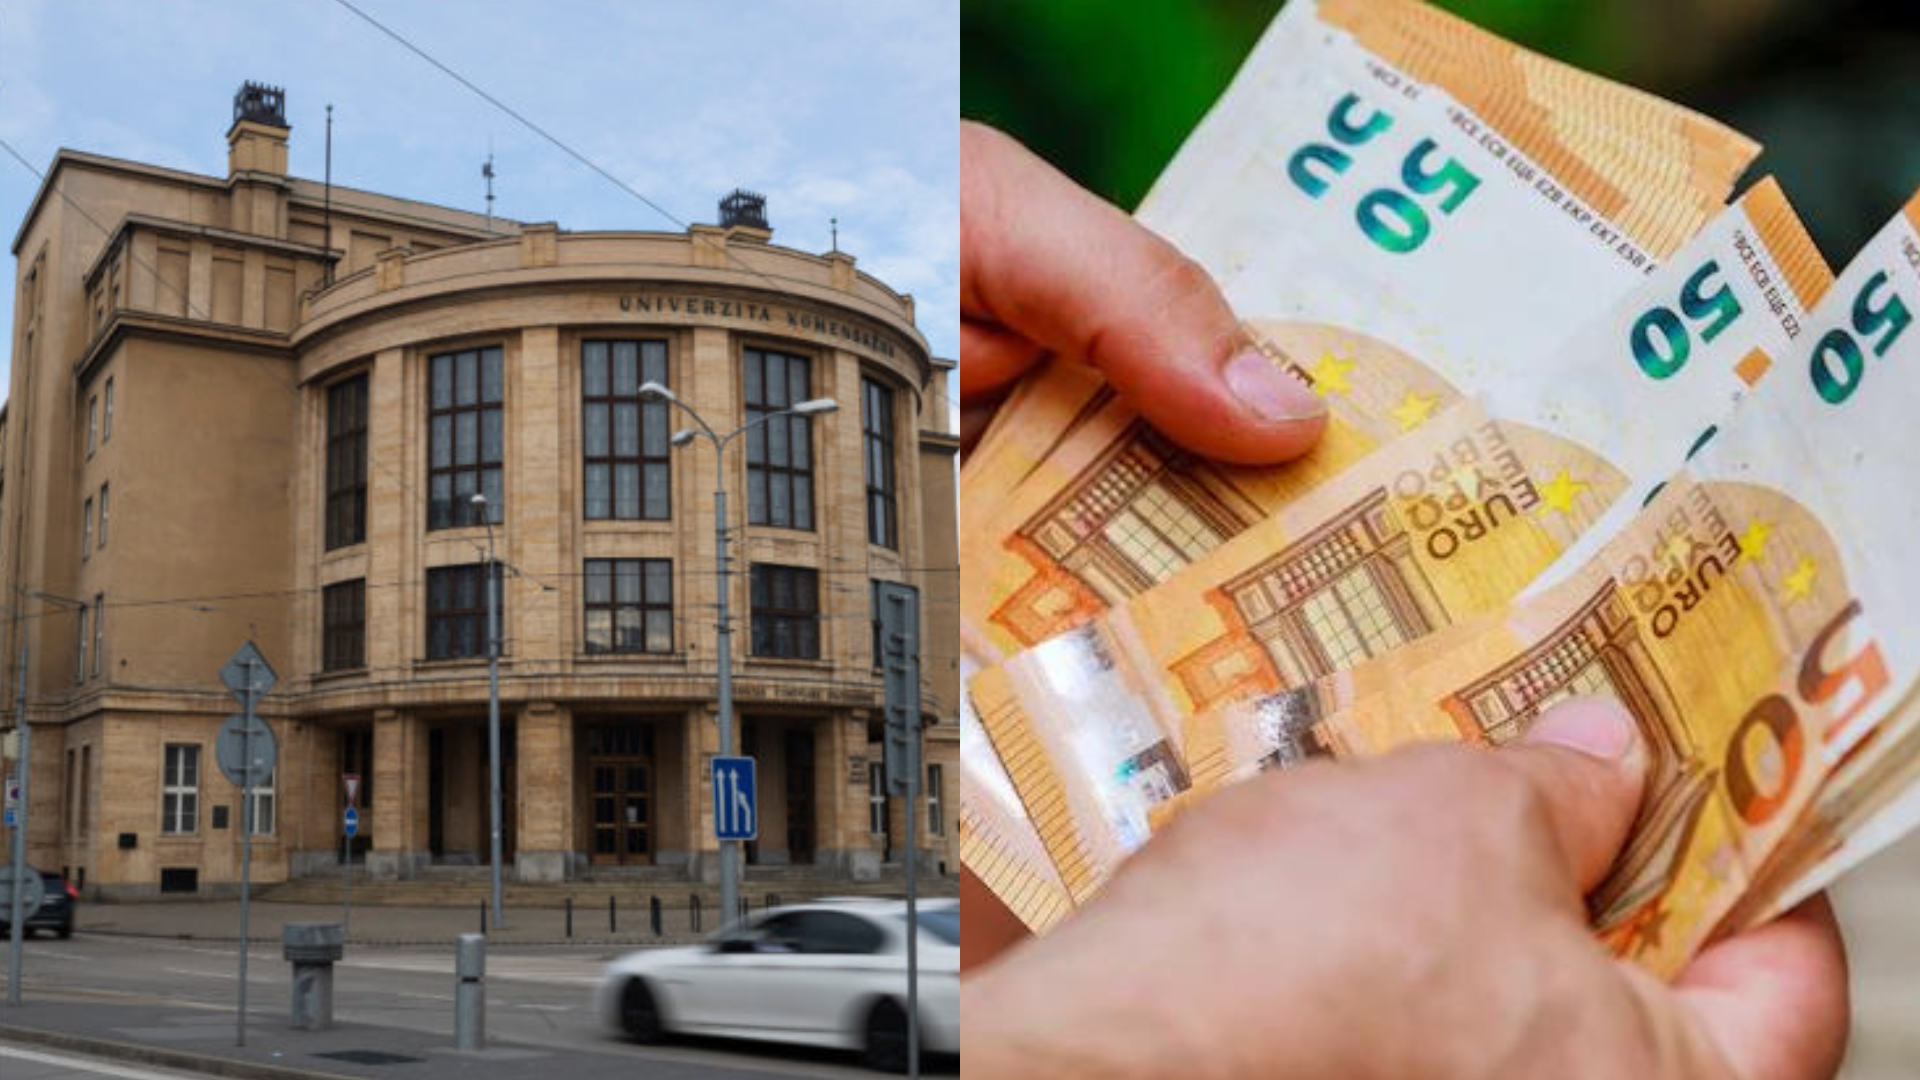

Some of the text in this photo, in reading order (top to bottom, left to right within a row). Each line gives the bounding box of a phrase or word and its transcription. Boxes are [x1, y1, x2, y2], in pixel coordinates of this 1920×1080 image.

[1355, 138, 1482, 254] 50
[619, 295, 770, 322] UNIVERZITA
[1630, 259, 1743, 380] 50
[1810, 270, 1912, 405] 50
[1426, 476, 1540, 559] EURO
[1649, 531, 1742, 636] EURO
[1726, 599, 1890, 828] 50
